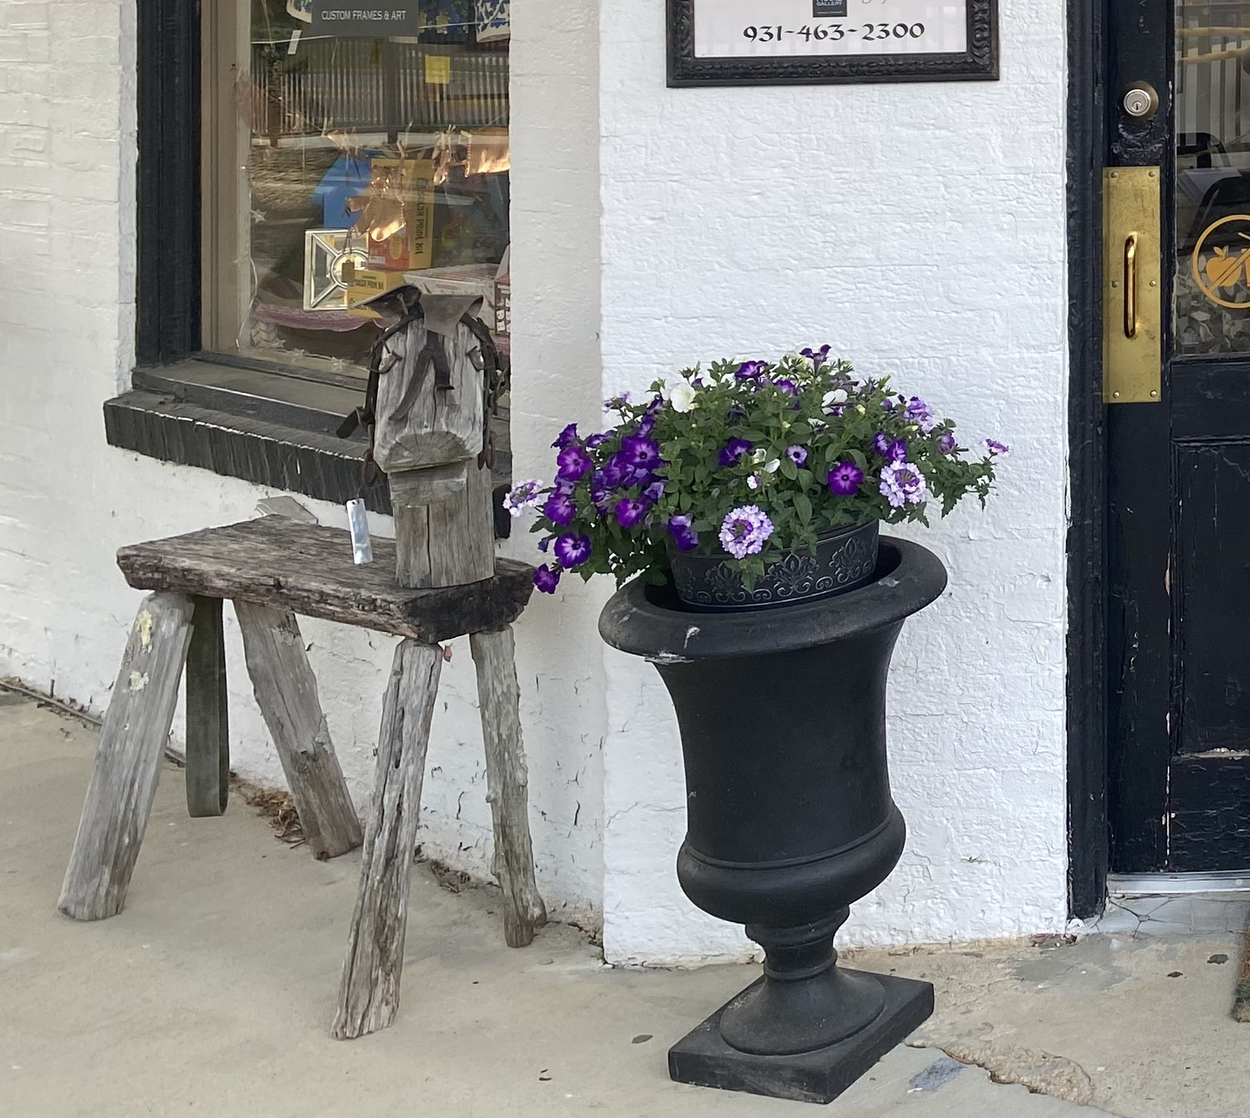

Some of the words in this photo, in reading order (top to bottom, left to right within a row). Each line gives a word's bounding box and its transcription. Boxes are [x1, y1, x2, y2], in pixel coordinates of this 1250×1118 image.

[321, 10, 351, 21] CUSTOM
[352, 10, 383, 21] FRAMES
[384, 10, 390, 21] &
[390, 9, 407, 21] ART
[742, 22, 926, 43] 931-463-2300
